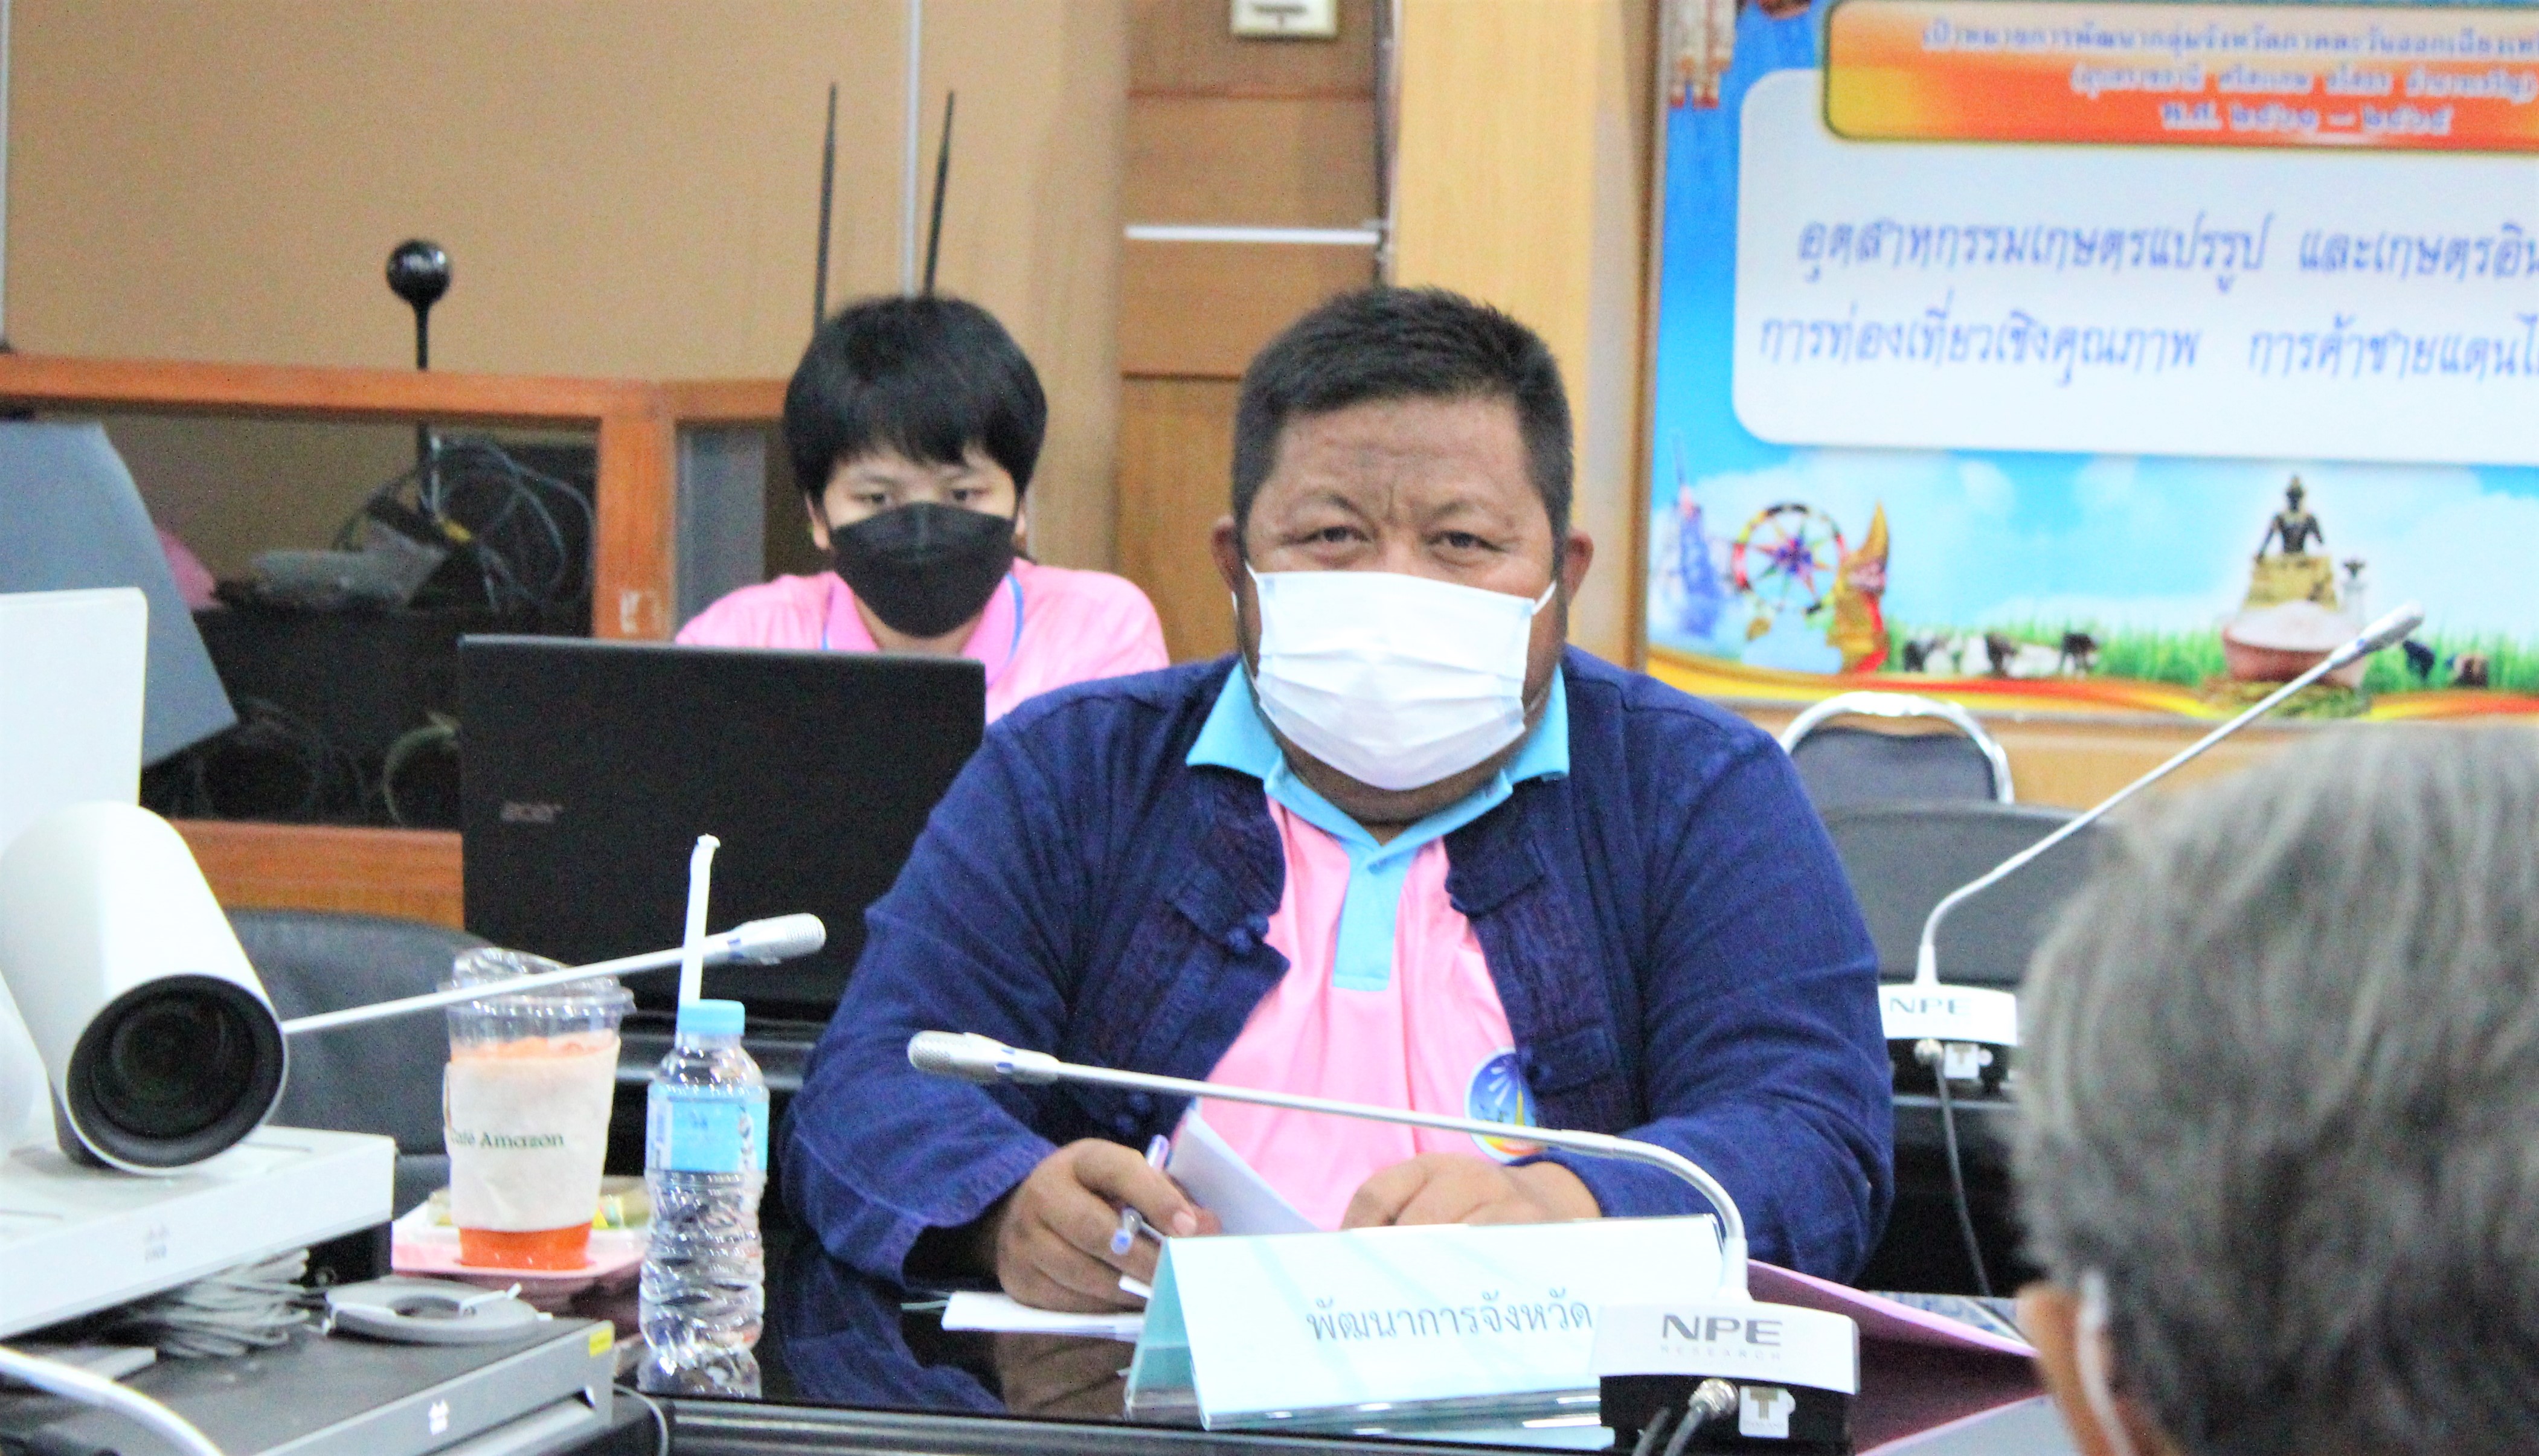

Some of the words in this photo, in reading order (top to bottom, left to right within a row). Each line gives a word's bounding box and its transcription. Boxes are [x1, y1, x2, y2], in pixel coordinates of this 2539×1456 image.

[1798, 211, 2273, 294] อุตสาหกรรมเกษตรแปรรูป
[1760, 286, 2201, 386] การท่องเที่ยวเชิงคุณภาพ
[2249, 312, 2539, 382] การค้าชายแดนไ
[1890, 998, 1971, 1015] NPE
[481, 1131, 565, 1149] Amazon
[1307, 1287, 1593, 1340] พัฒนาการจังหวัด
[1663, 1313, 1783, 1347] NPE
